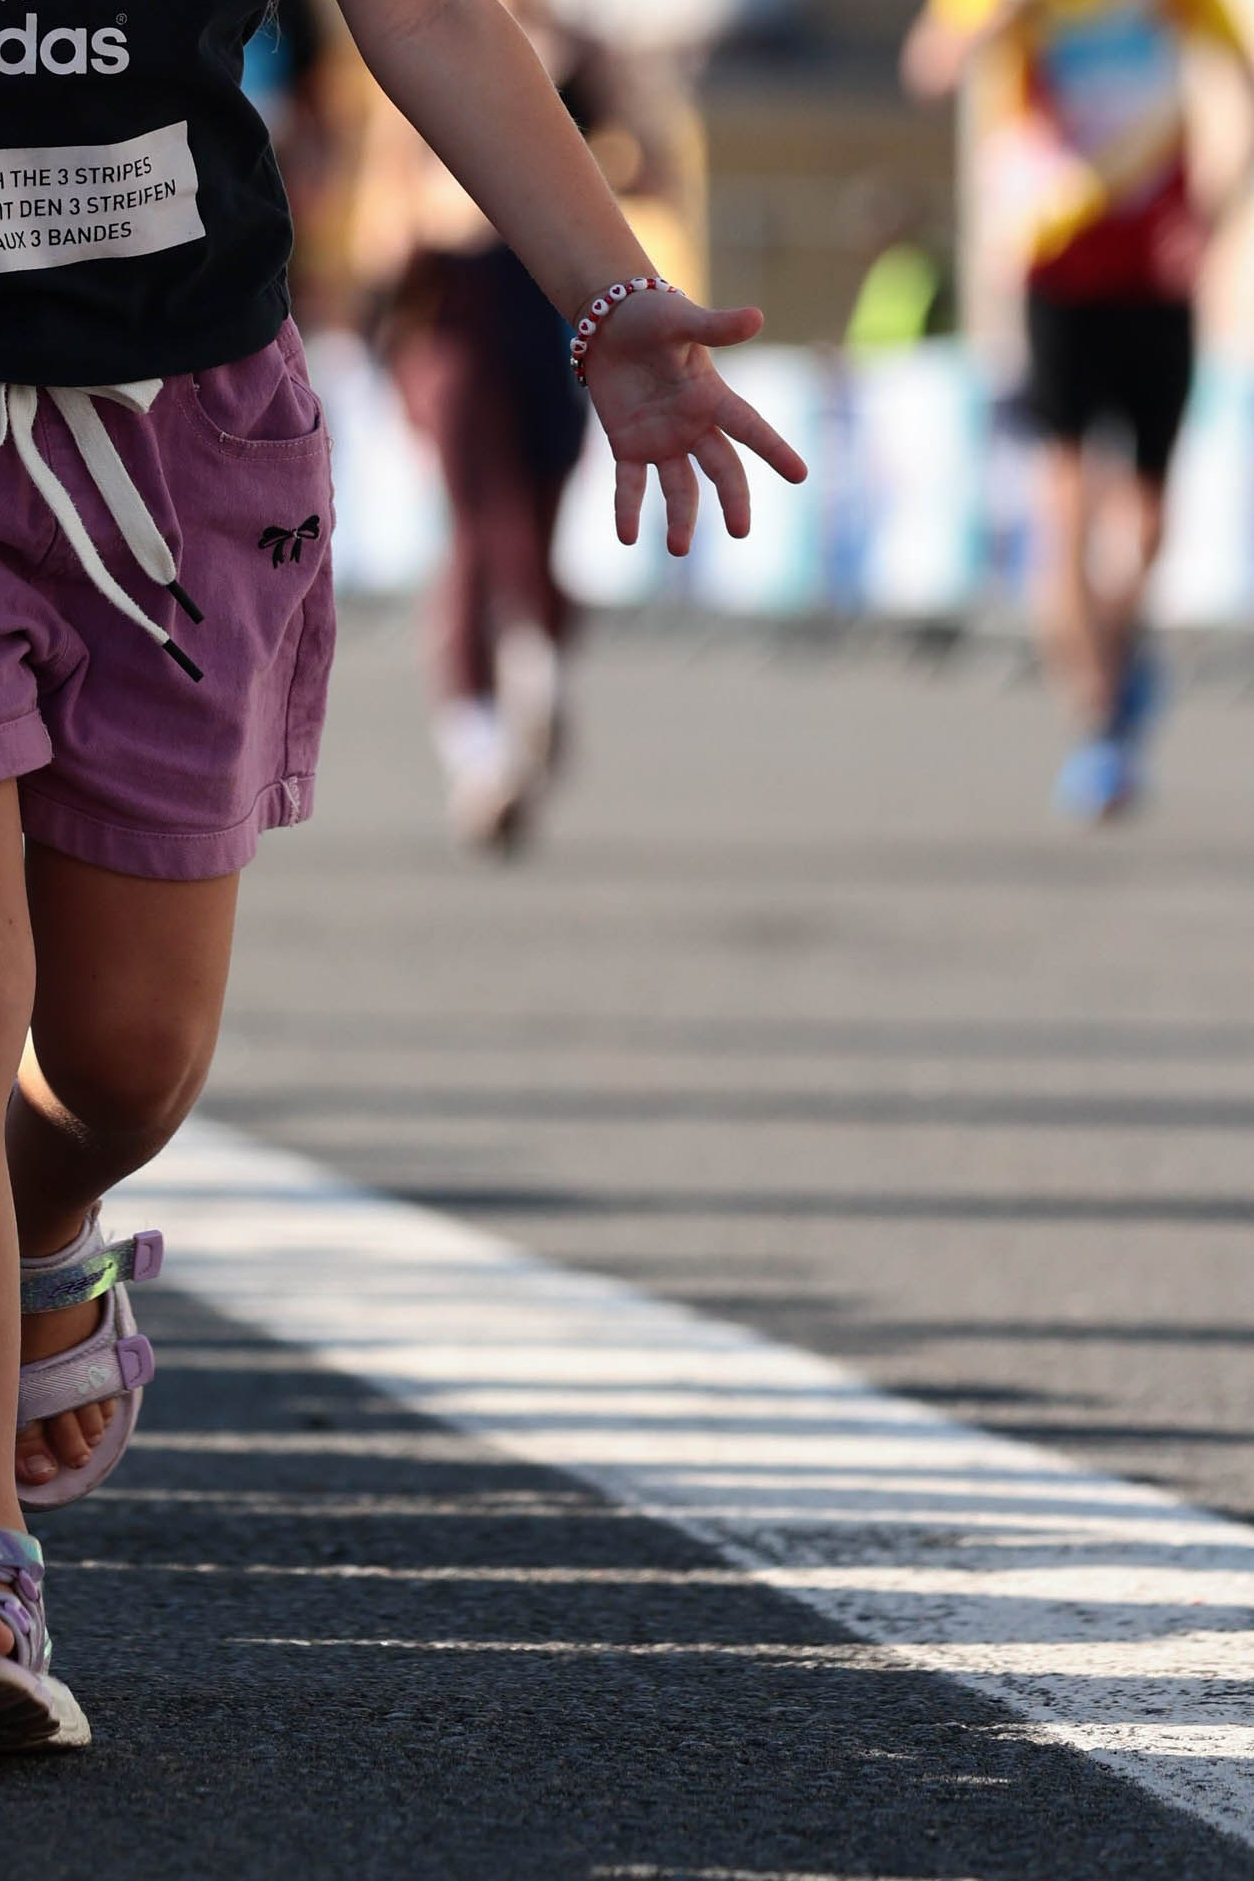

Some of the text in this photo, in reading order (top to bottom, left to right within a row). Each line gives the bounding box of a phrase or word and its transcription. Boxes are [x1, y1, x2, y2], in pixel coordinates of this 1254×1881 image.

[10, 168, 51, 188] THE
[57, 168, 69, 186] 3
[75, 156, 153, 185] STRIPES
[20, 198, 62, 218] DEN
[69, 197, 80, 216] 3
[86, 179, 176, 215] STREIFEN
[30, 229, 41, 247] 3
[48, 221, 132, 247] BANDES
